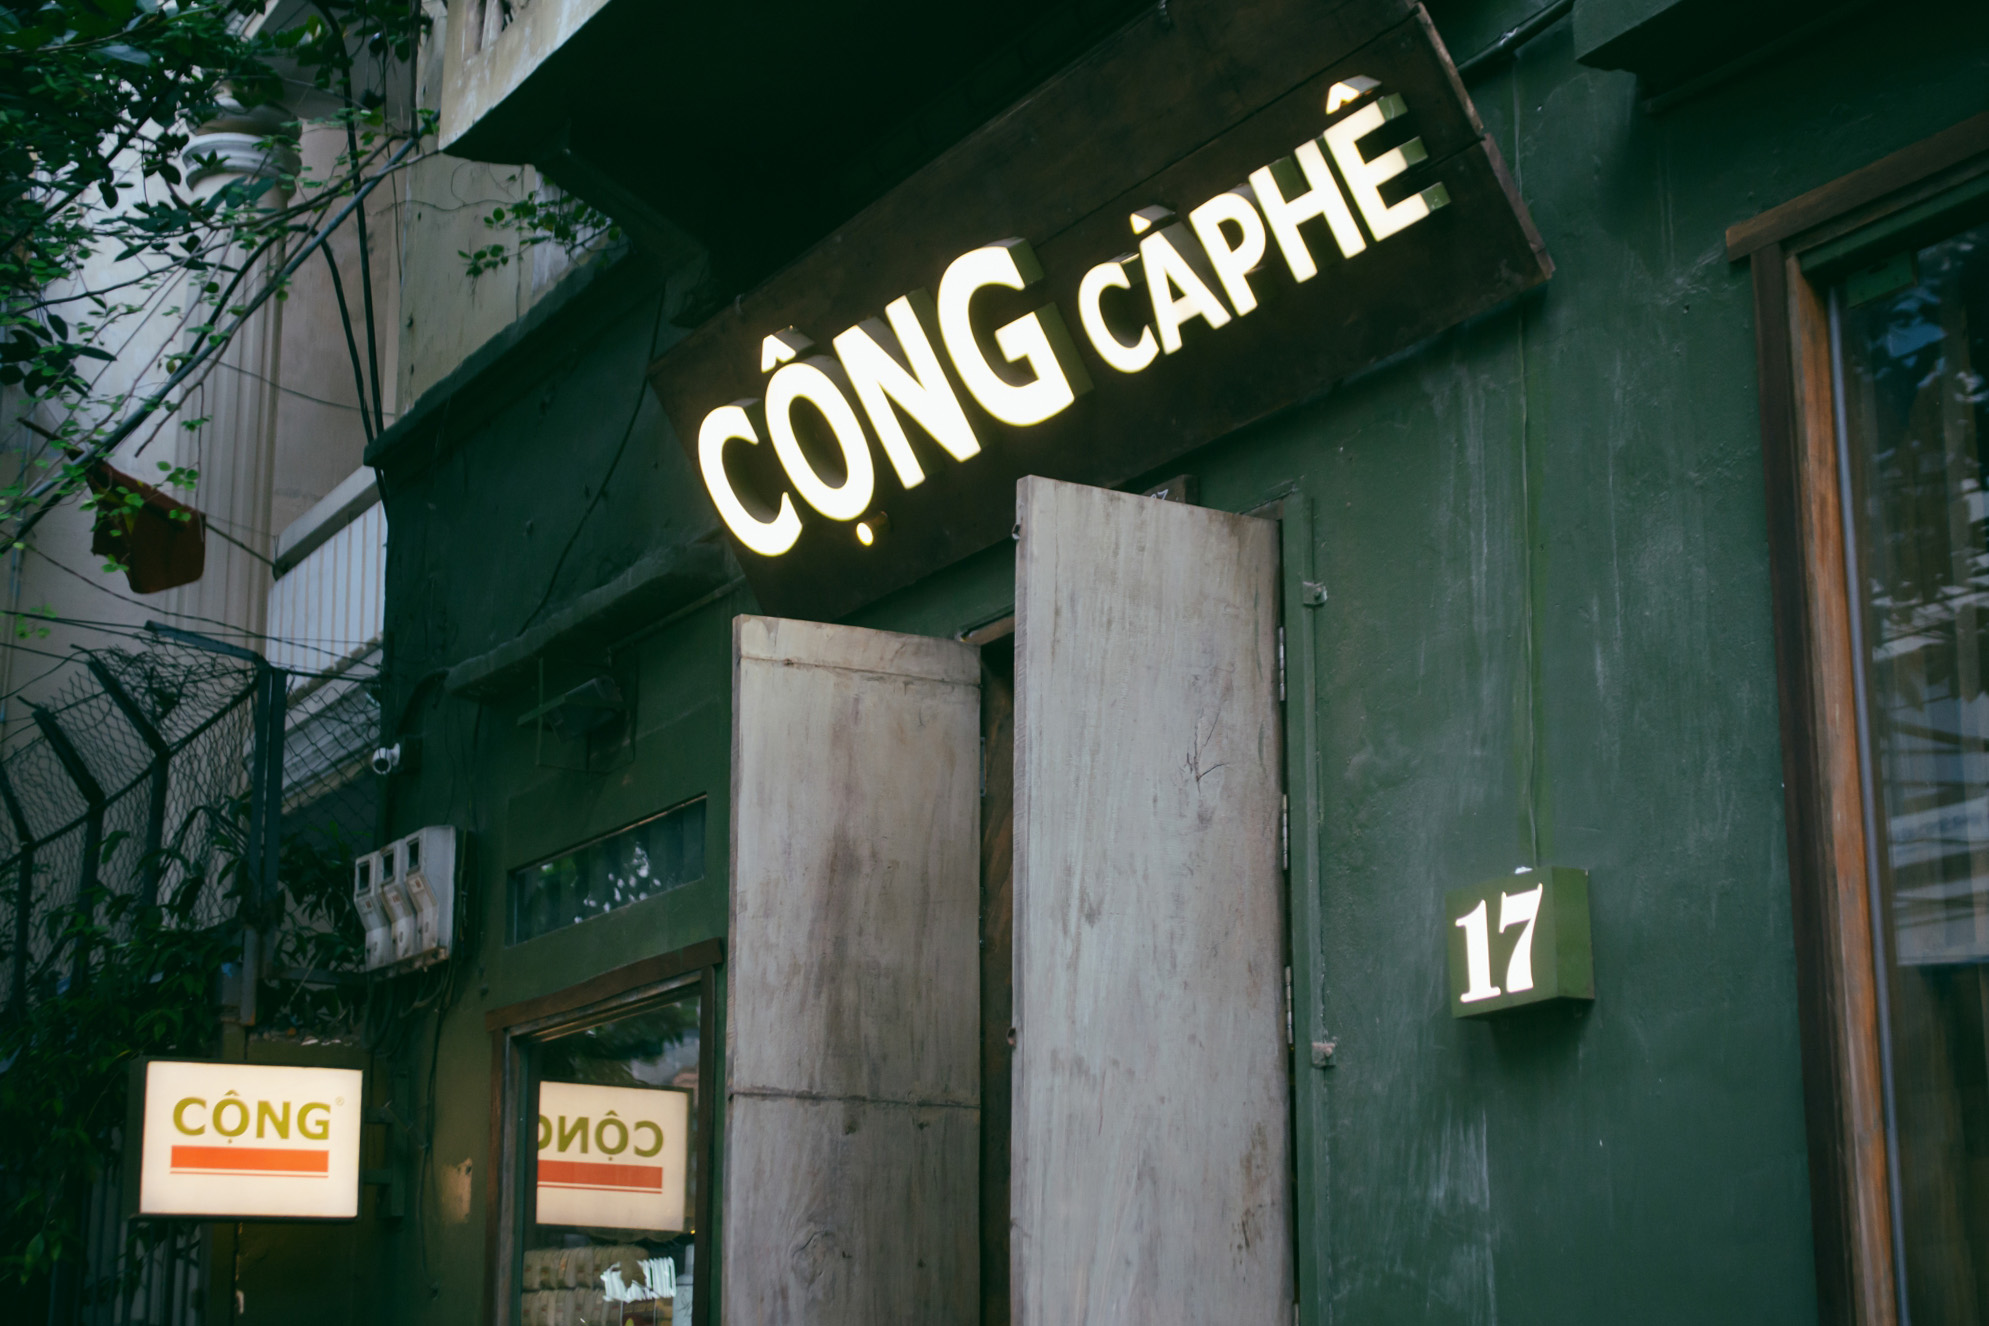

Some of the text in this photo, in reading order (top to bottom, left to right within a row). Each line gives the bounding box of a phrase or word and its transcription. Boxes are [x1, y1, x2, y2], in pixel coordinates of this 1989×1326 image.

[697, 244, 1076, 557] CỘNG
[1455, 882, 1543, 1003] 17
[172, 1089, 331, 1144] CỘNG
